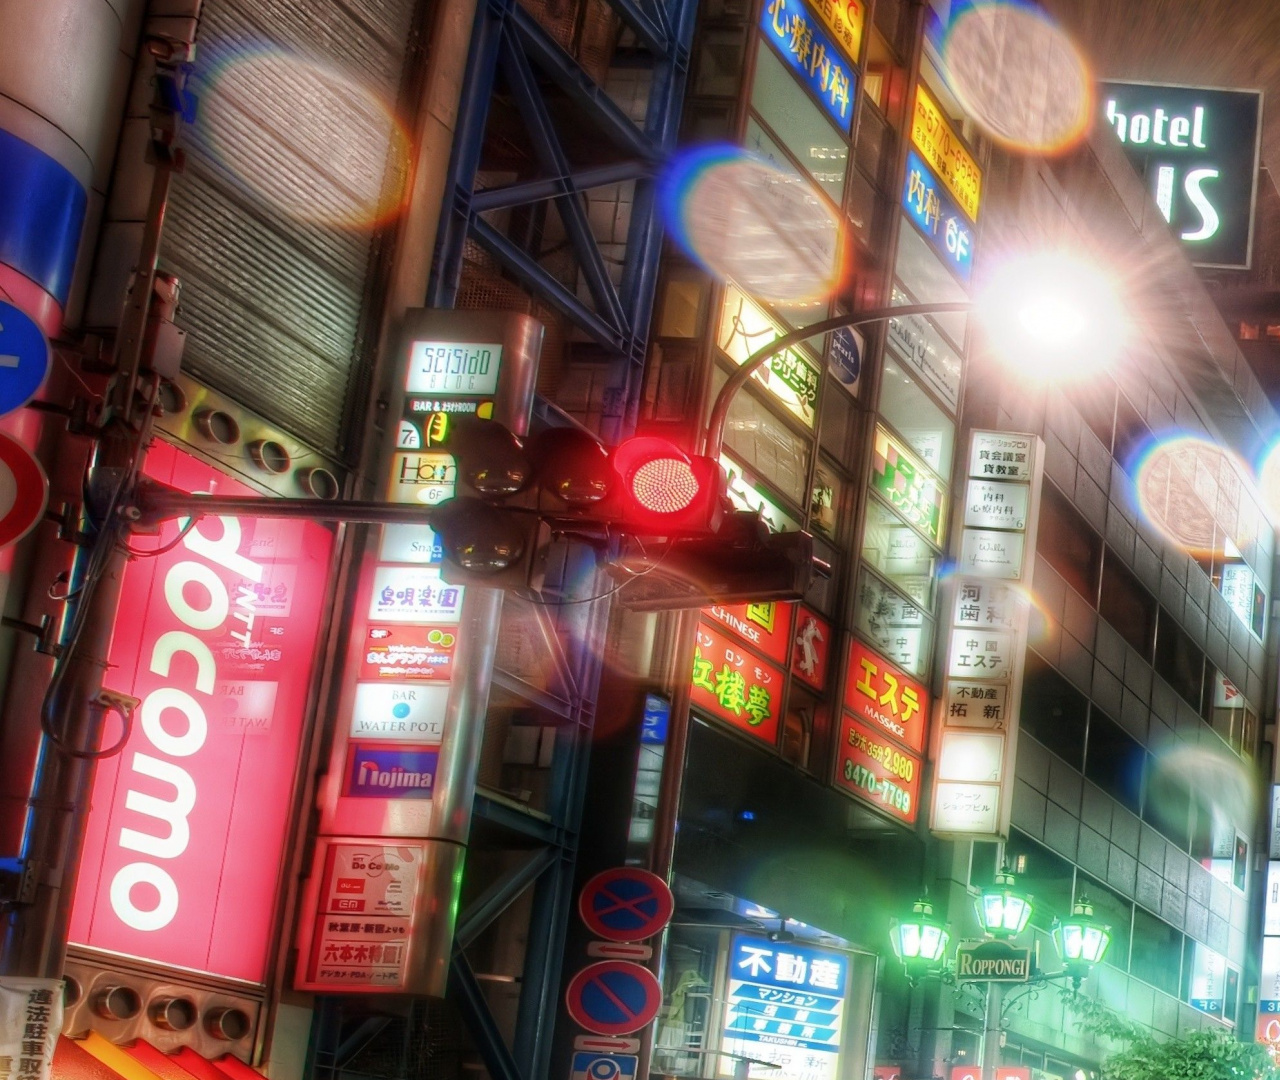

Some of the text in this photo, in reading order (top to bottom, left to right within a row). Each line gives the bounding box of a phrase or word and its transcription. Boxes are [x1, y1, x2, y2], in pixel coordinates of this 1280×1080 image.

[1107, 100, 1206, 149] hotel
[945, 217, 969, 262] 6F
[413, 400, 432, 412] BAR
[402, 429, 416, 445] 7F
[428, 488, 443, 500] 6F
[1016, 520, 1023, 529] 6
[232, 584, 261, 649] NTT
[959, 605, 1005, 623] 歯科
[711, 605, 761, 644] CHINESE
[965, 639, 998, 652] 中国
[724, 648, 772, 684] ロン モン
[956, 653, 1003, 668] エステ
[1002, 669, 1009, 678] 3
[391, 689, 417, 701] BAR
[856, 656, 920, 723] エステ
[956, 686, 999, 700] 不動産
[109, 491, 264, 933] docomo
[360, 720, 438, 733] WATER POT
[863, 704, 906, 739] MASSAGE
[996, 720, 1003, 730] 2
[844, 759, 911, 815] 3470-7799
[738, 945, 841, 990] 不動産
[960, 953, 1026, 977] ROPPONGI
[757, 987, 818, 1007] マンション
[758, 1035, 797, 1047] TAKUSHIN
